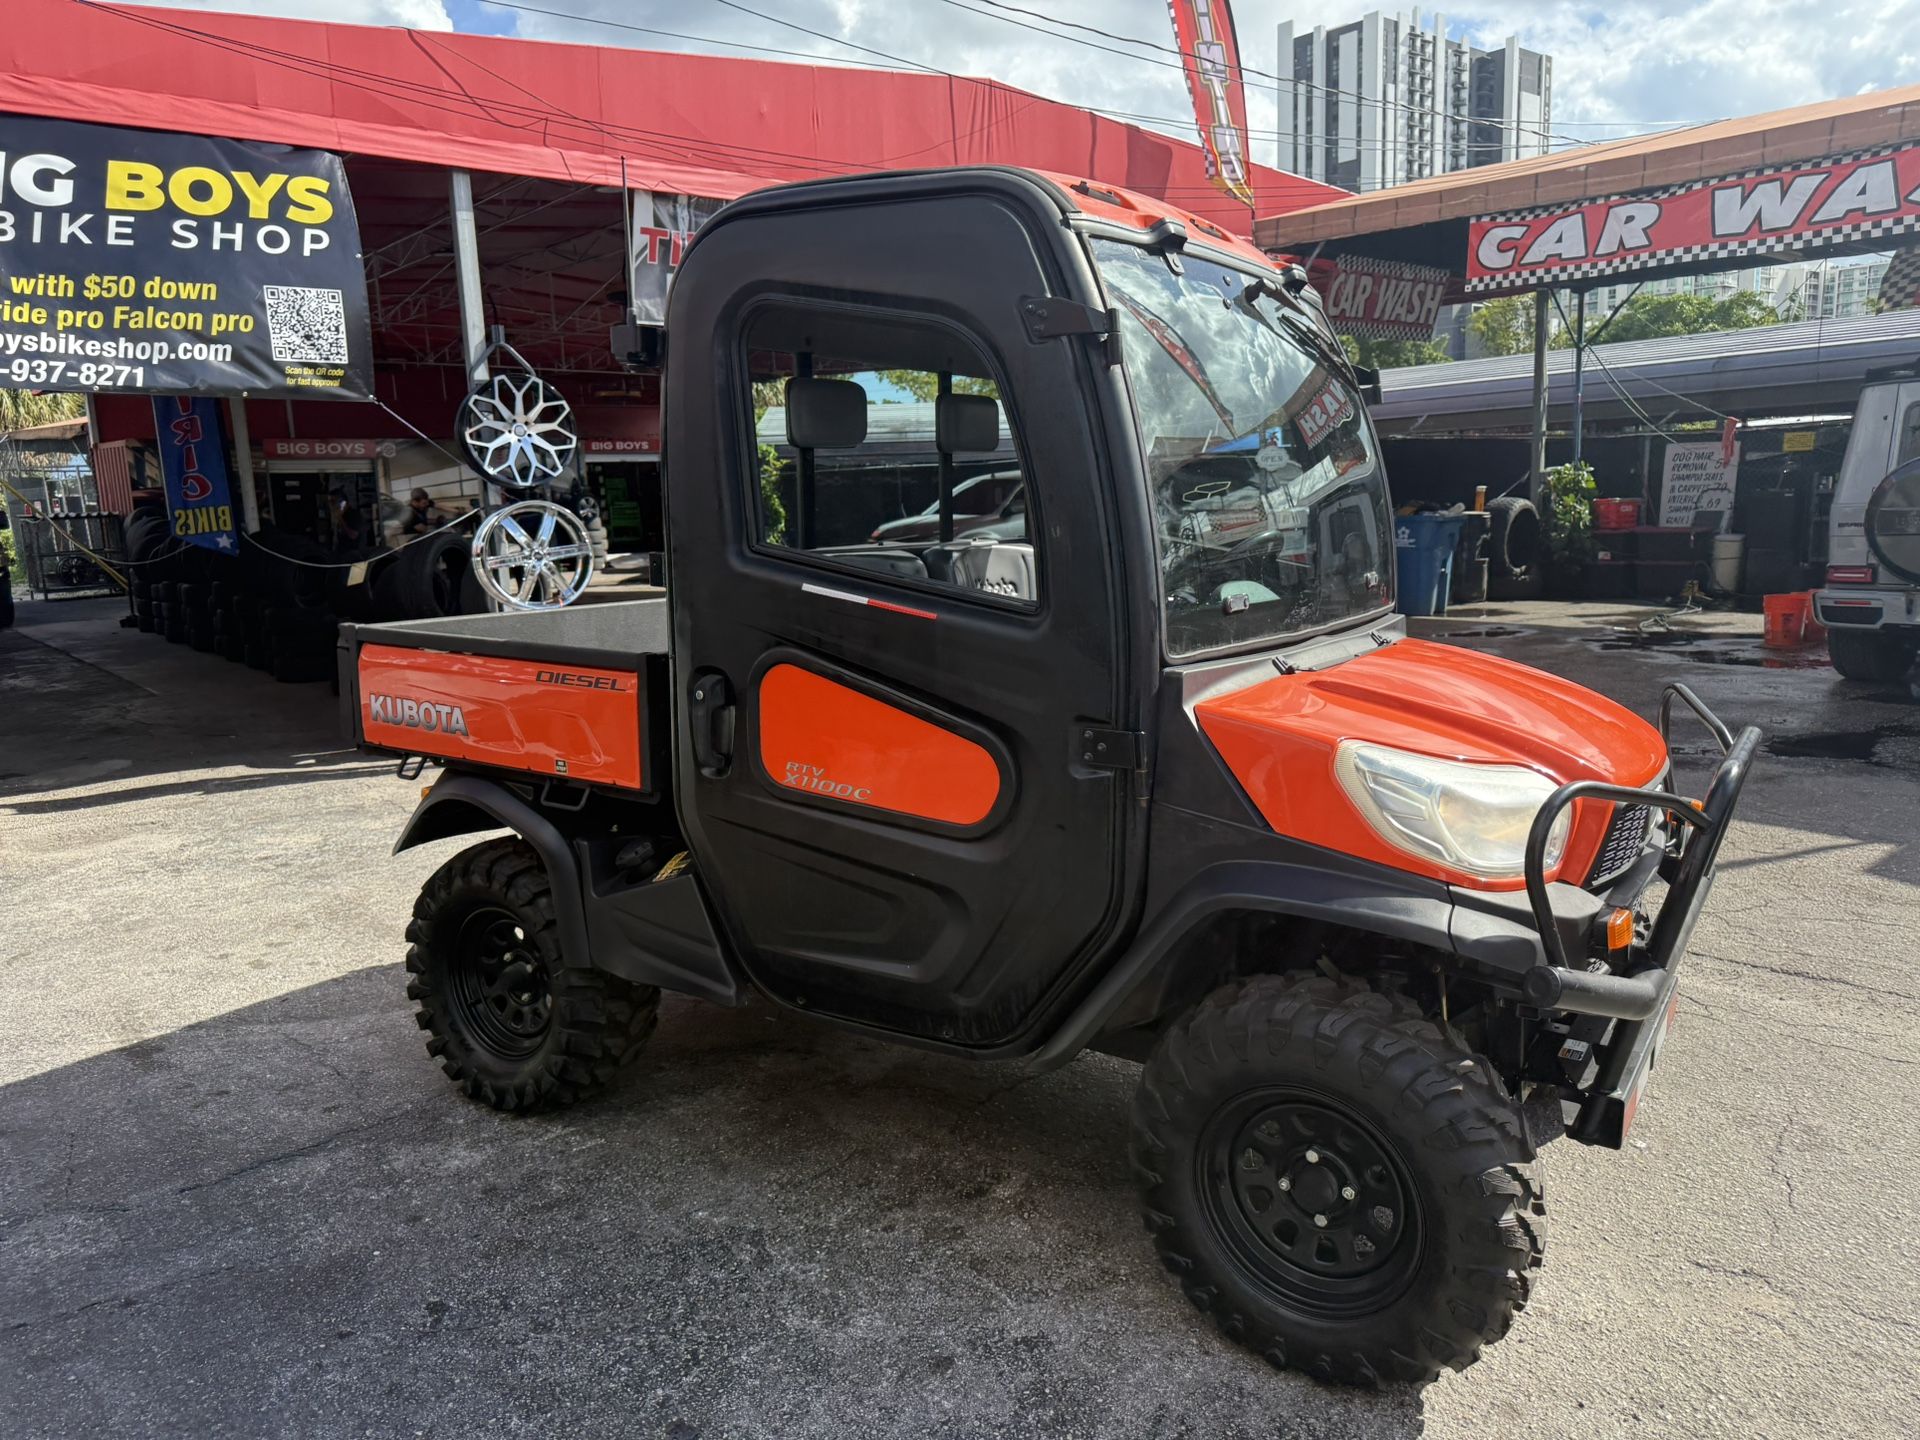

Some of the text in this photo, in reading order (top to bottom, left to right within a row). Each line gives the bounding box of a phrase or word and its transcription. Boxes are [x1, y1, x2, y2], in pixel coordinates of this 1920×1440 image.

[105, 160, 334, 224] BOYS
[1477, 159, 1920, 269] CAR WA
[171, 218, 330, 257] SHOP
[640, 226, 696, 267] TI
[10, 273, 217, 300] with $50 down
[1327, 272, 1444, 325] CAR WASH
[56, 308, 104, 331] pro
[113, 305, 203, 331] Falcon
[210, 312, 254, 336] pro
[0, 331, 232, 364] ysbikeshop.com
[285, 366, 303, 375] Scan
[315, 367, 327, 376] QR
[327, 368, 345, 377] code
[286, 377, 341, 387] for fast approval
[276, 442, 366, 455] BIG BOYS
[591, 441, 649, 450] BIG BOYS
[535, 670, 627, 691] DIESEL
[369, 692, 469, 736] KUBOTA
[785, 761, 825, 777] RTV
[783, 771, 873, 801] X1100C
